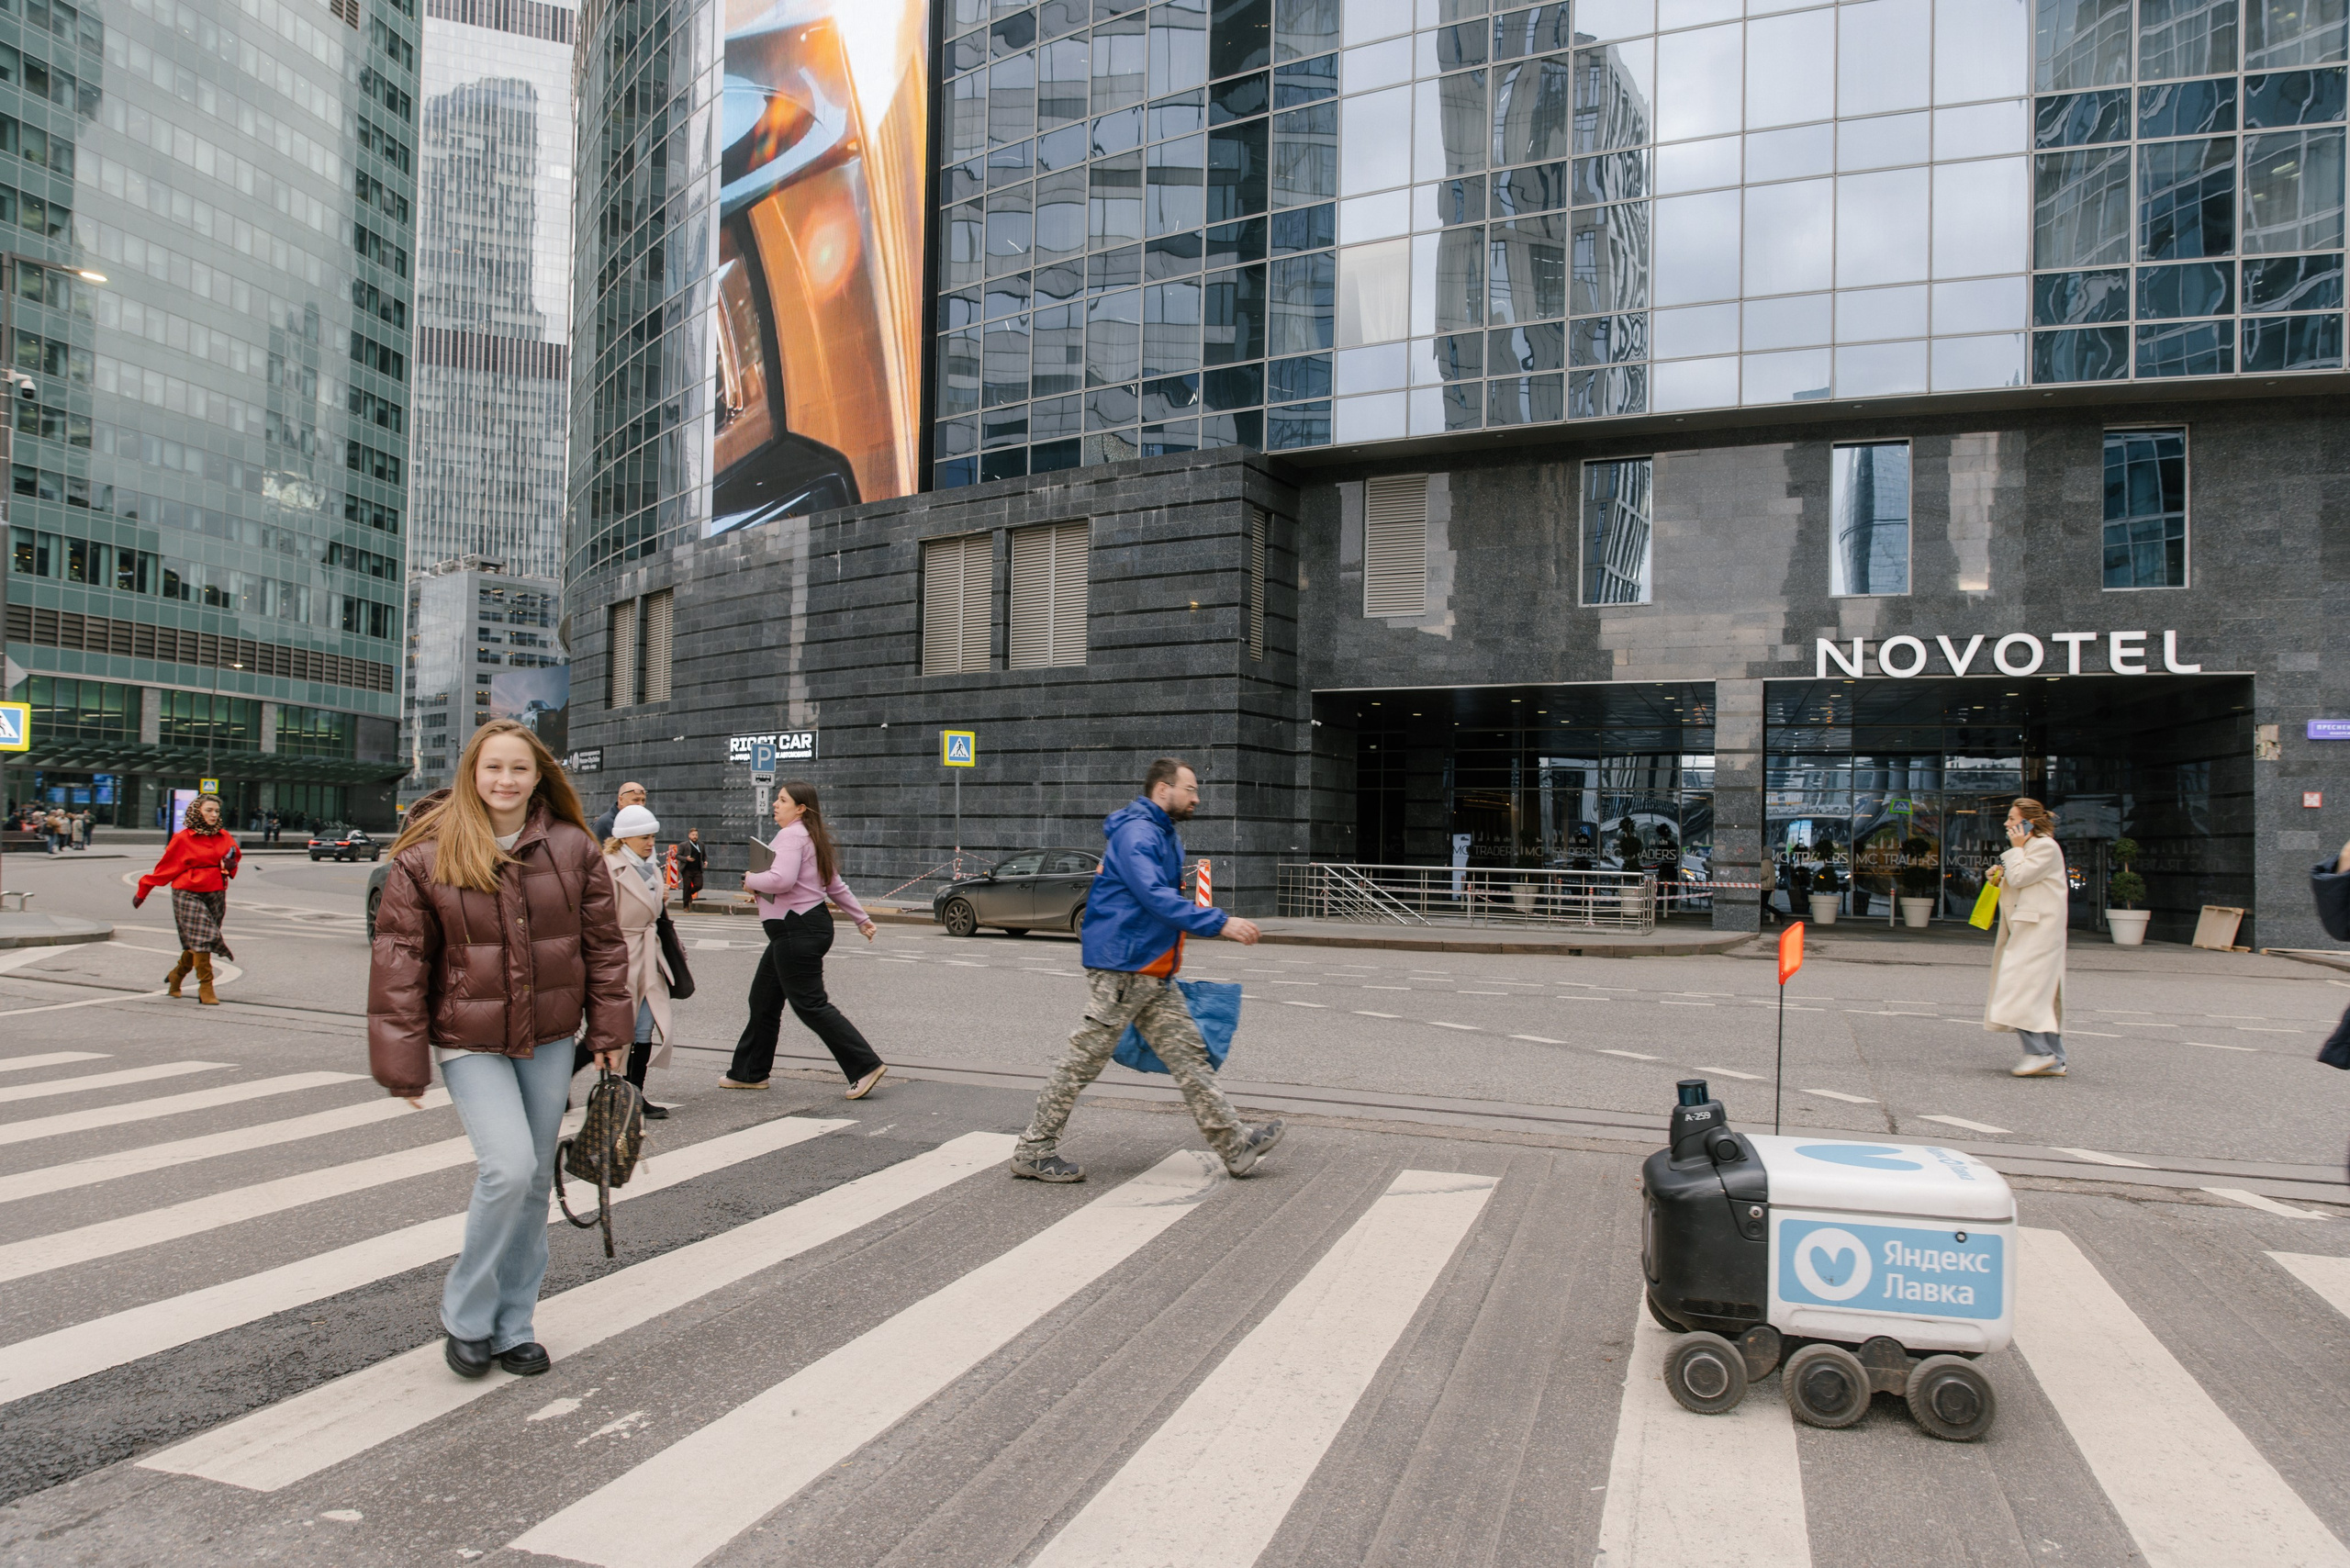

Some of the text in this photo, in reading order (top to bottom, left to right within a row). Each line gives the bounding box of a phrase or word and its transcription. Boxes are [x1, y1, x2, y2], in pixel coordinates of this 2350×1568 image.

[1817, 630, 2201, 678] NOVOTEL
[778, 734, 812, 750] CAR
[757, 746, 772, 768] P
[1525, 846, 1544, 857] MC
[1855, 853, 1878, 865] MC
[1946, 855, 1967, 866] MC
[1883, 1239, 1990, 1273] Яндекс
[1882, 1272, 1975, 1305] Лавка
